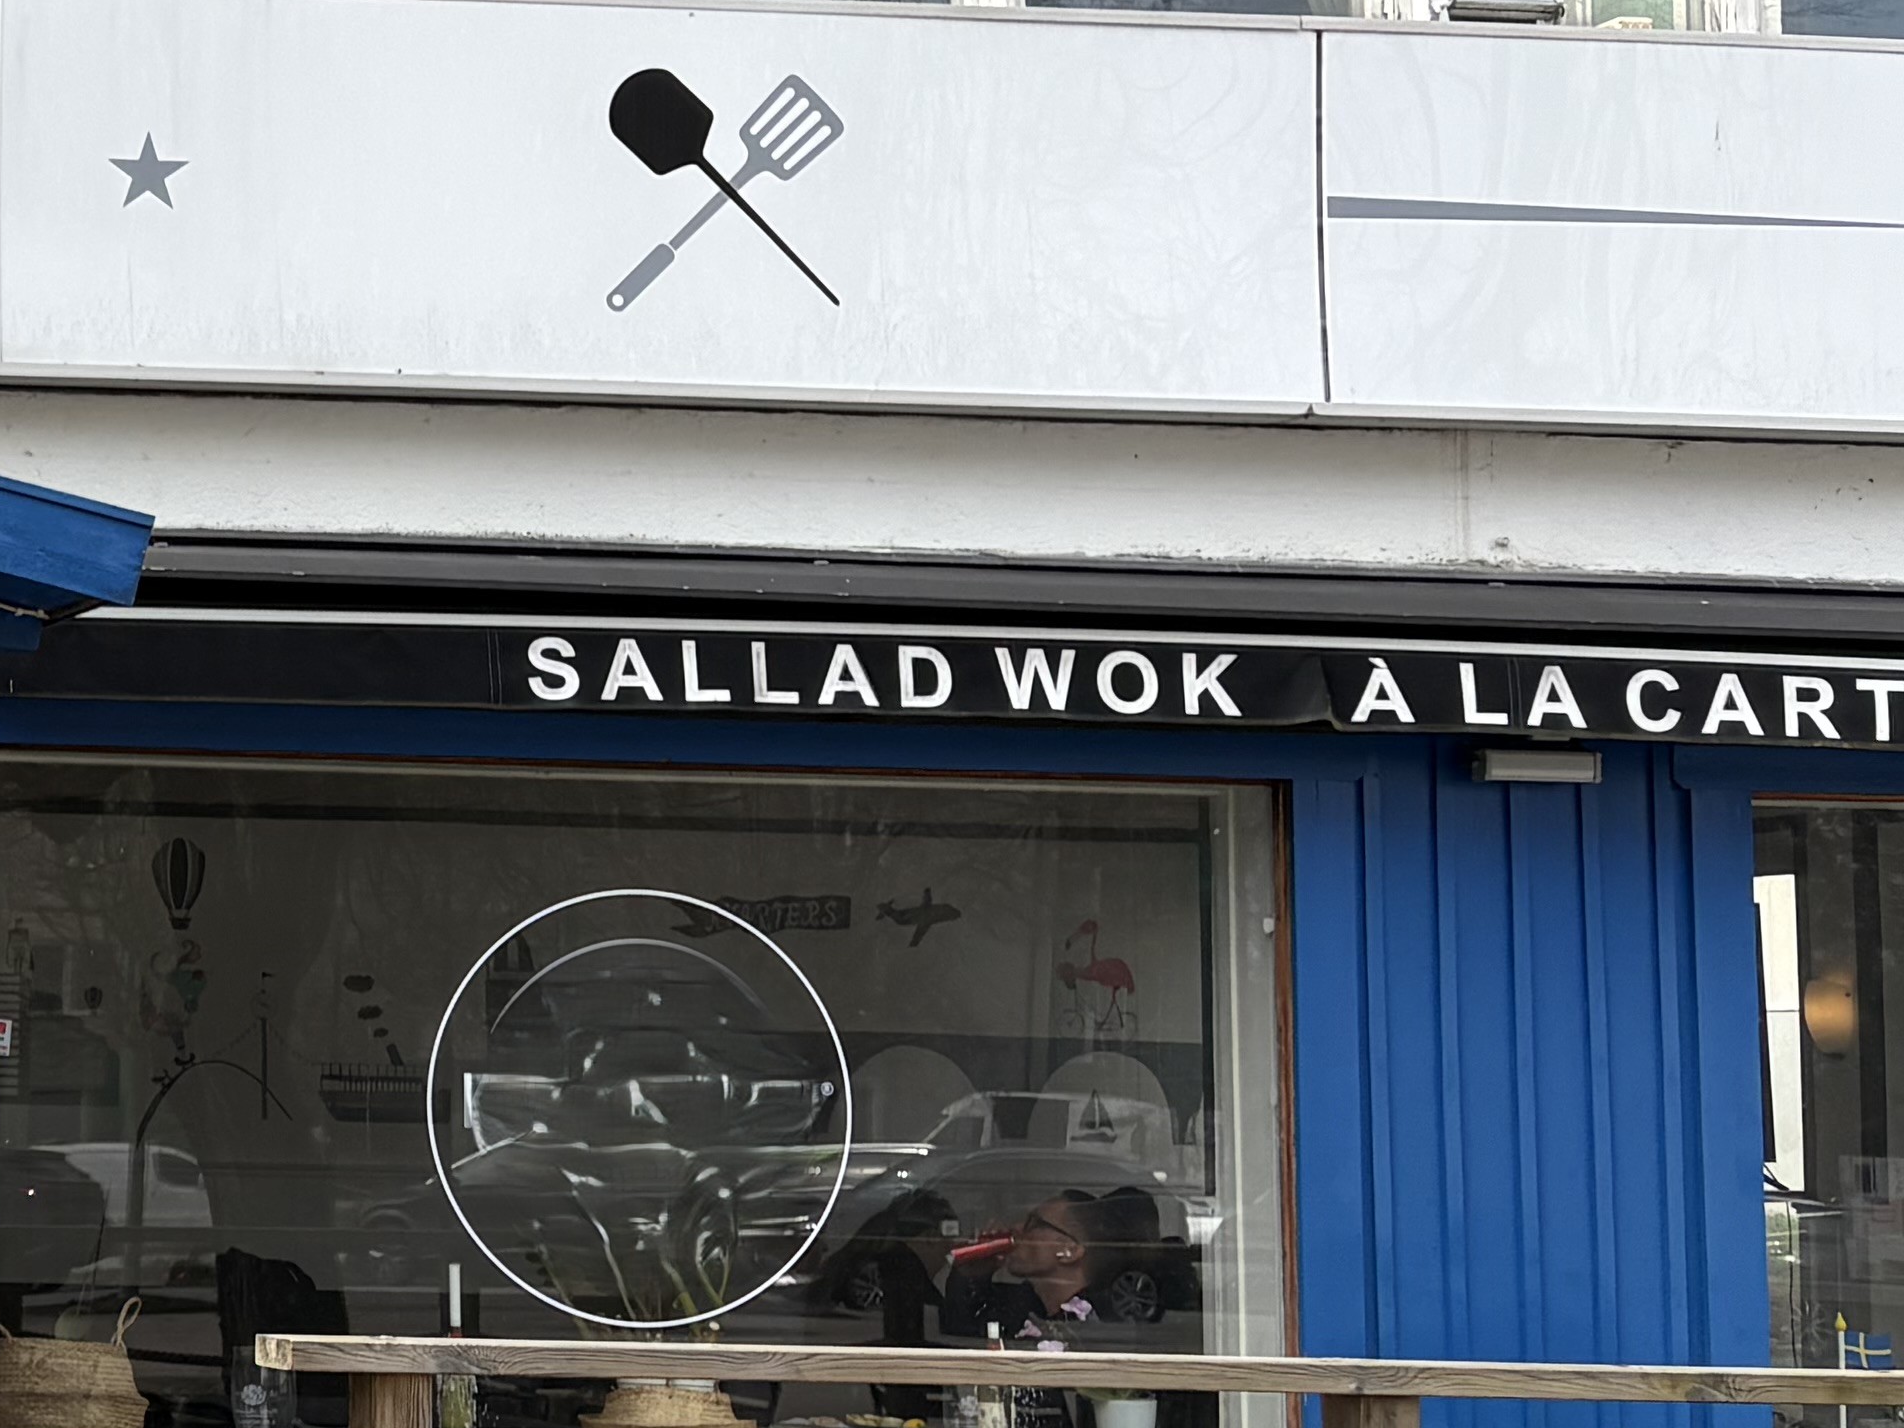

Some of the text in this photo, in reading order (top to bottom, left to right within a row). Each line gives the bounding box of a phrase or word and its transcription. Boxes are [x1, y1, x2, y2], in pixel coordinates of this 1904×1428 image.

[526, 635, 954, 709] SALLAD
[993, 646, 1243, 718] WOK
[1458, 661, 1589, 730] LA
[1625, 668, 1904, 743] CART
